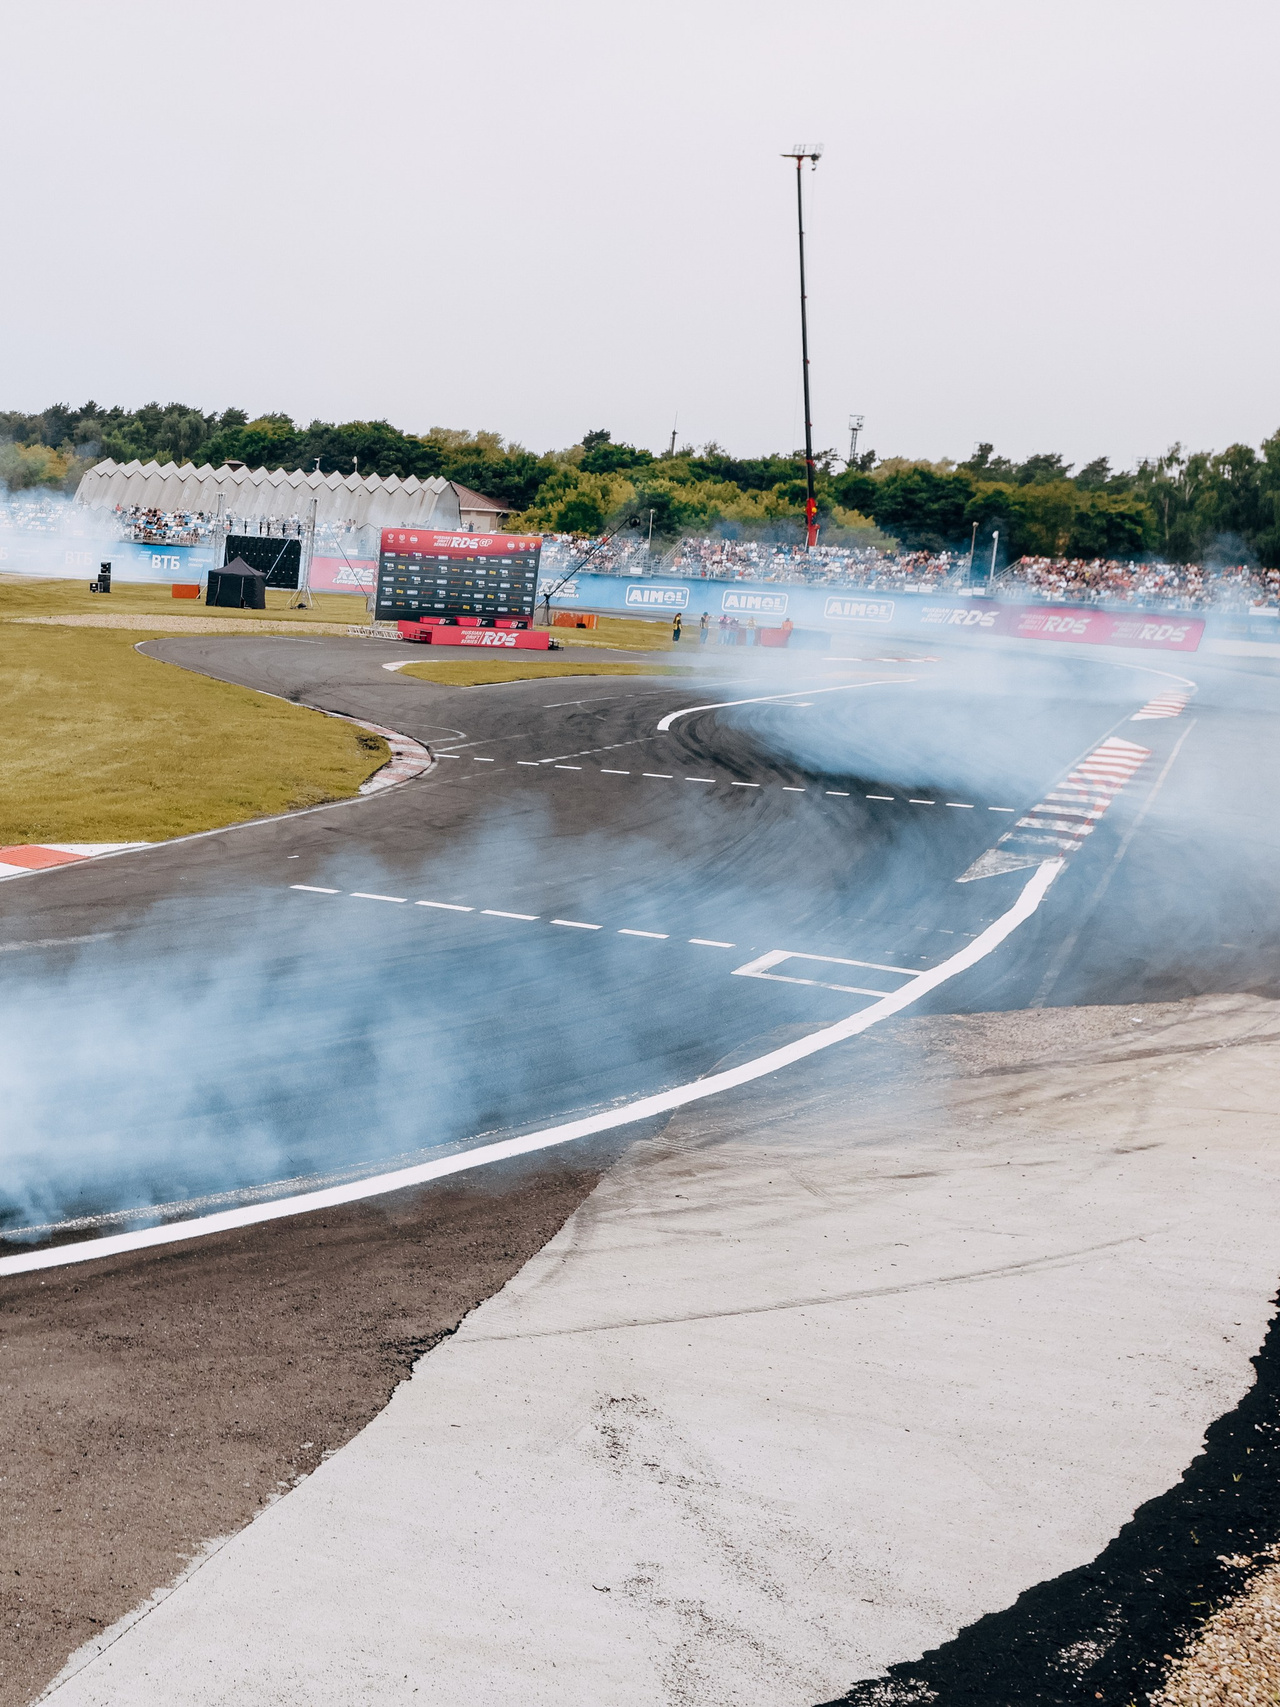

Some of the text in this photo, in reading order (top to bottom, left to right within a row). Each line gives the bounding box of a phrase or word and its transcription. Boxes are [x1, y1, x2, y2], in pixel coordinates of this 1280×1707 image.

[450, 537, 493, 549] RDS GP
[151, 554, 181, 570] ВТБ
[629, 589, 685, 604] AIMOL
[725, 594, 784, 611] AIMOL
[827, 602, 890, 618] AIMOL
[948, 609, 1000, 627] RDS
[1043, 615, 1091, 634] RDS
[1139, 623, 1191, 642] RDS
[481, 631, 520, 647] RDS
